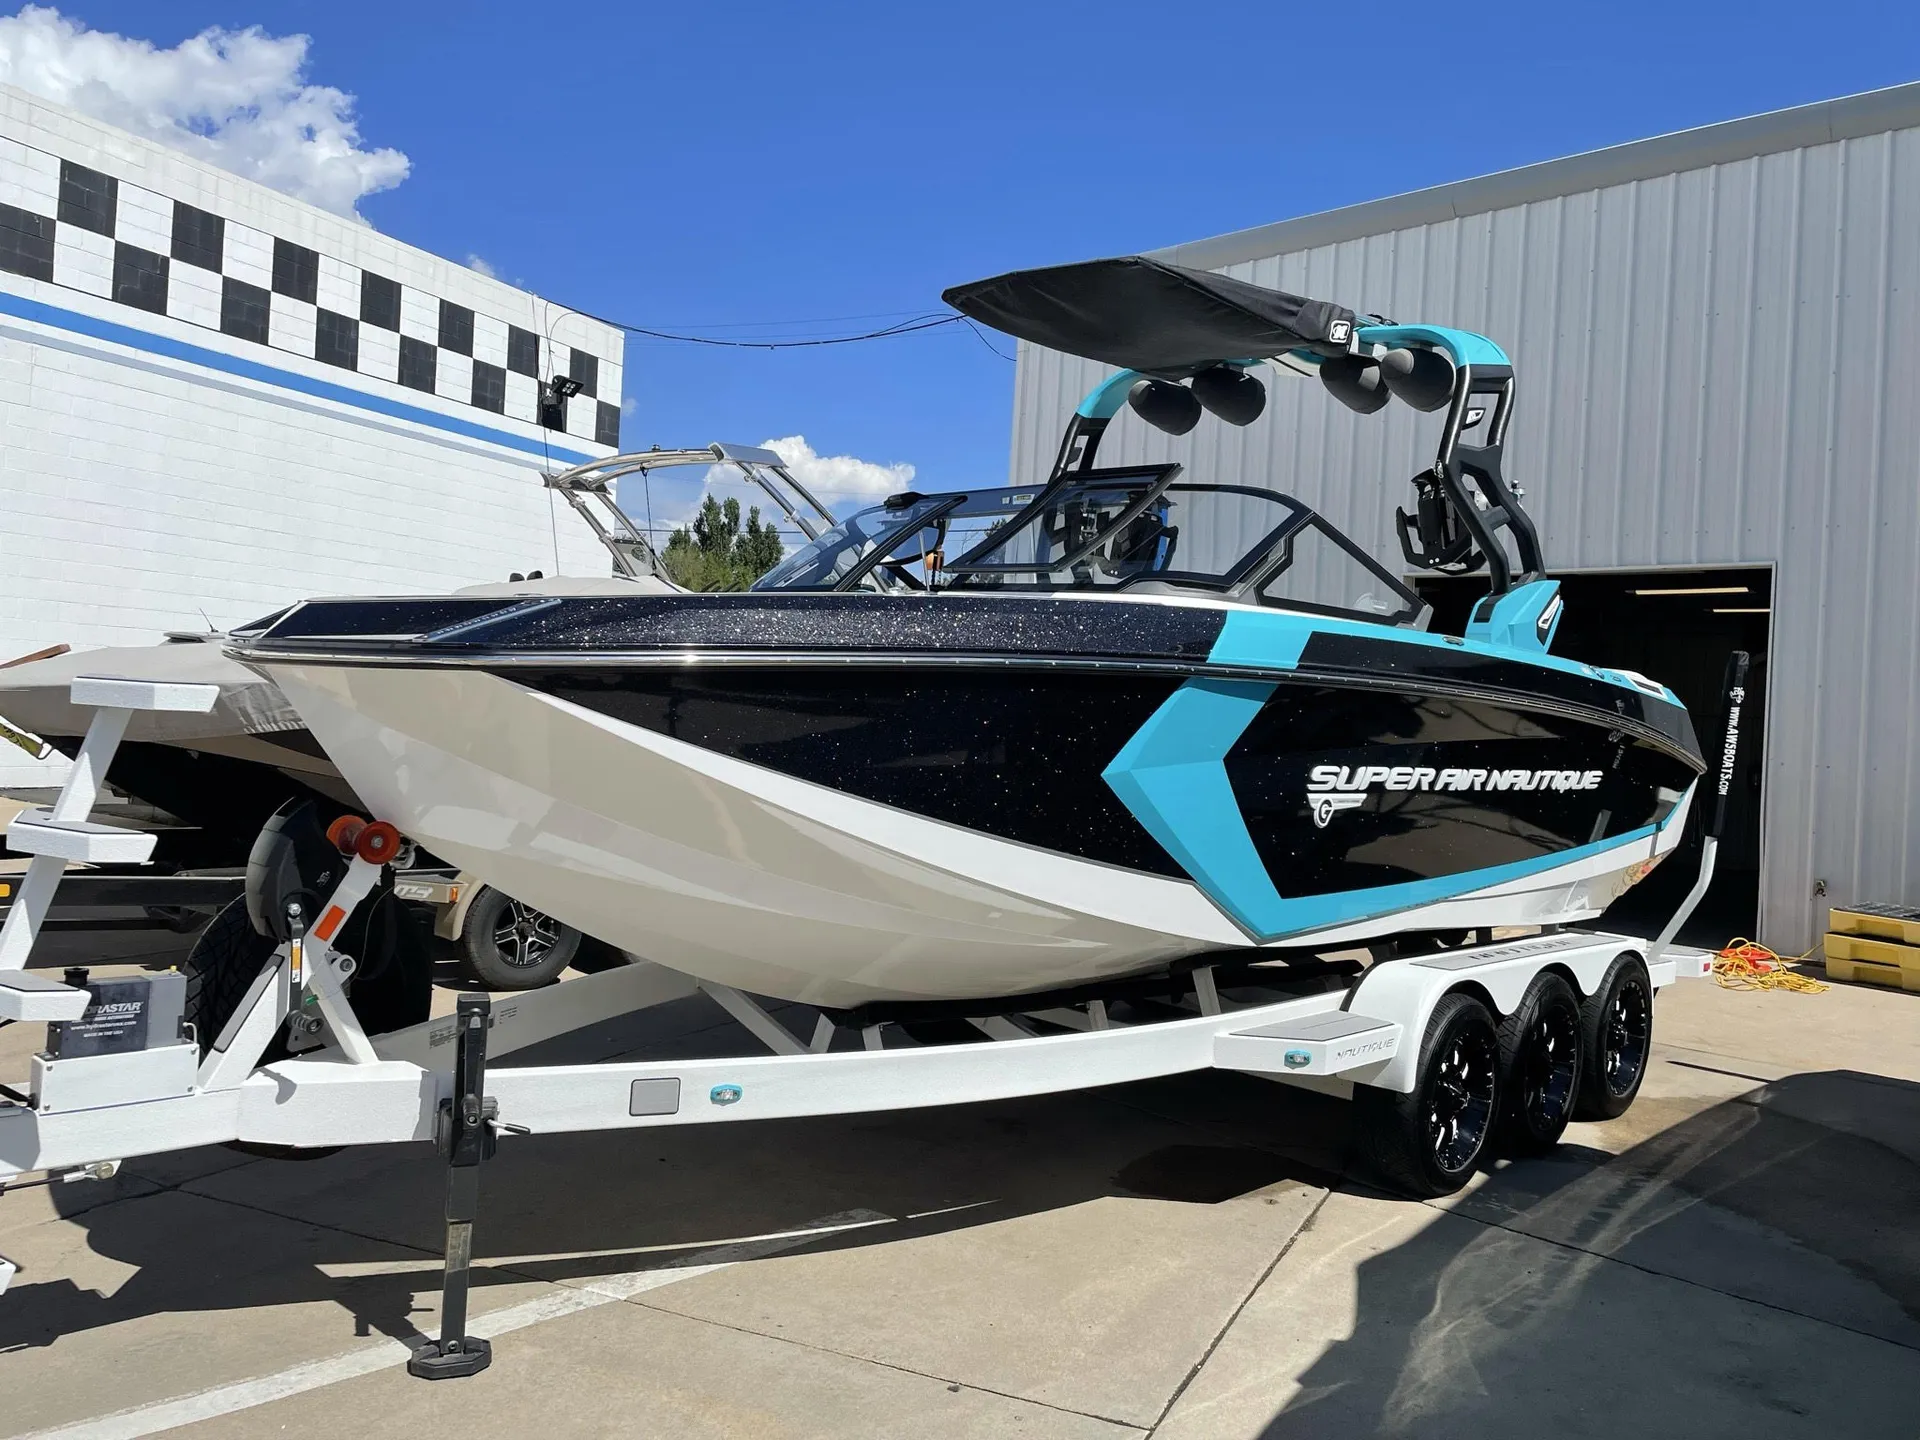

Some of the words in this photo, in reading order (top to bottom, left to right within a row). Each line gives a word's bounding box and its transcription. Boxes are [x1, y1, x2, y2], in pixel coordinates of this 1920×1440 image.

[1718, 707, 1740, 795] WWW.AWSBOATS.COM
[1307, 765, 1436, 791] SUPER
[1434, 768, 1488, 791] AIR
[1486, 769, 1603, 793] NAUTIQUE
[84, 1001, 142, 1014] DRASTAR
[1336, 1038, 1394, 1060] NAUTIQUE
